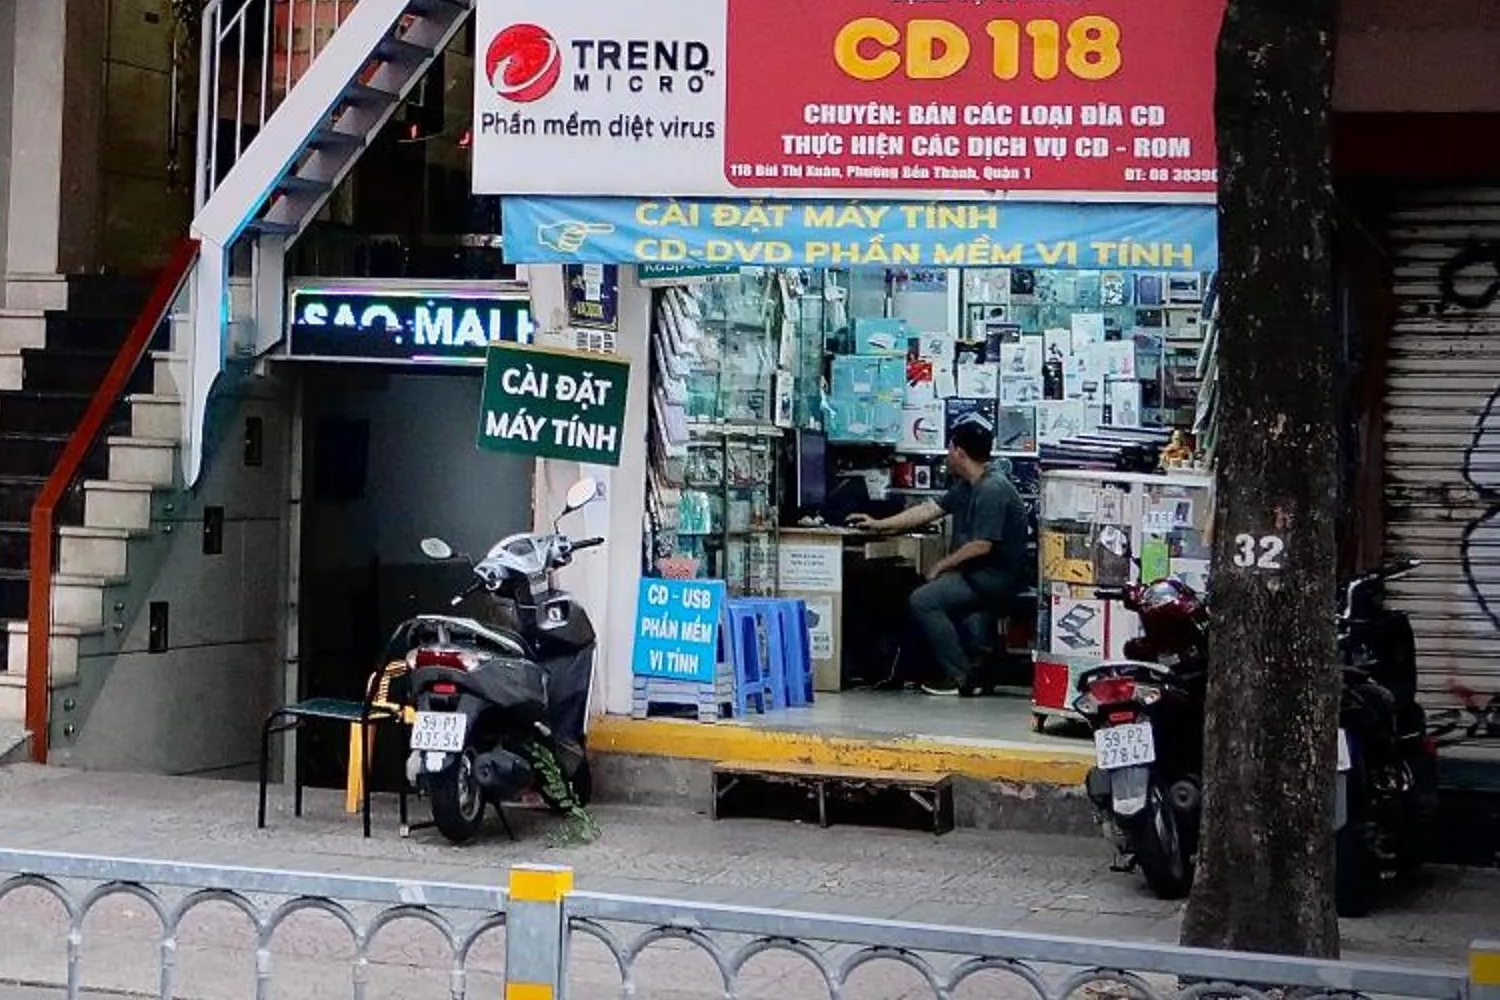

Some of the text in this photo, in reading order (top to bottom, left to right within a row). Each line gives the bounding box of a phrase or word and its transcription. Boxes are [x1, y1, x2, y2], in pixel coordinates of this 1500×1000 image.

[571, 40, 709, 71] TREND
[833, 14, 1123, 81] CD 118
[573, 75, 704, 94] MICRO
[608, 113, 654, 141] diệt
[660, 115, 716, 138] virus
[804, 101, 902, 126] CHUYÊN:
[908, 101, 957, 126] BÁN
[963, 101, 1013, 126] CÁC
[1020, 105, 1073, 130] LOẠI
[1130, 105, 1166, 127] CD
[781, 132, 844, 159] THỰC
[850, 132, 905, 159] HIỆN
[911, 133, 961, 157] CÁC
[967, 136, 1028, 161] DỊCH
[1034, 137, 1068, 161] VỤ
[1075, 137, 1109, 158] CD
[1133, 137, 1191, 158] ROM
[635, 198, 998, 234] CÀI ĐẶT MÁY TÍNH
[635, 239, 793, 263] CD-DVD
[1035, 240, 1078, 266] VI
[1089, 236, 1194, 268] TÍNH
[414, 305, 500, 346] MAI
[502, 363, 612, 411] CÀI ĐẶT
[485, 408, 617, 452] MÁY TÍNH
[1233, 532, 1285, 571] 32
[647, 583, 669, 605] CD
[682, 587, 712, 609] USB
[649, 648, 664, 672] VI
